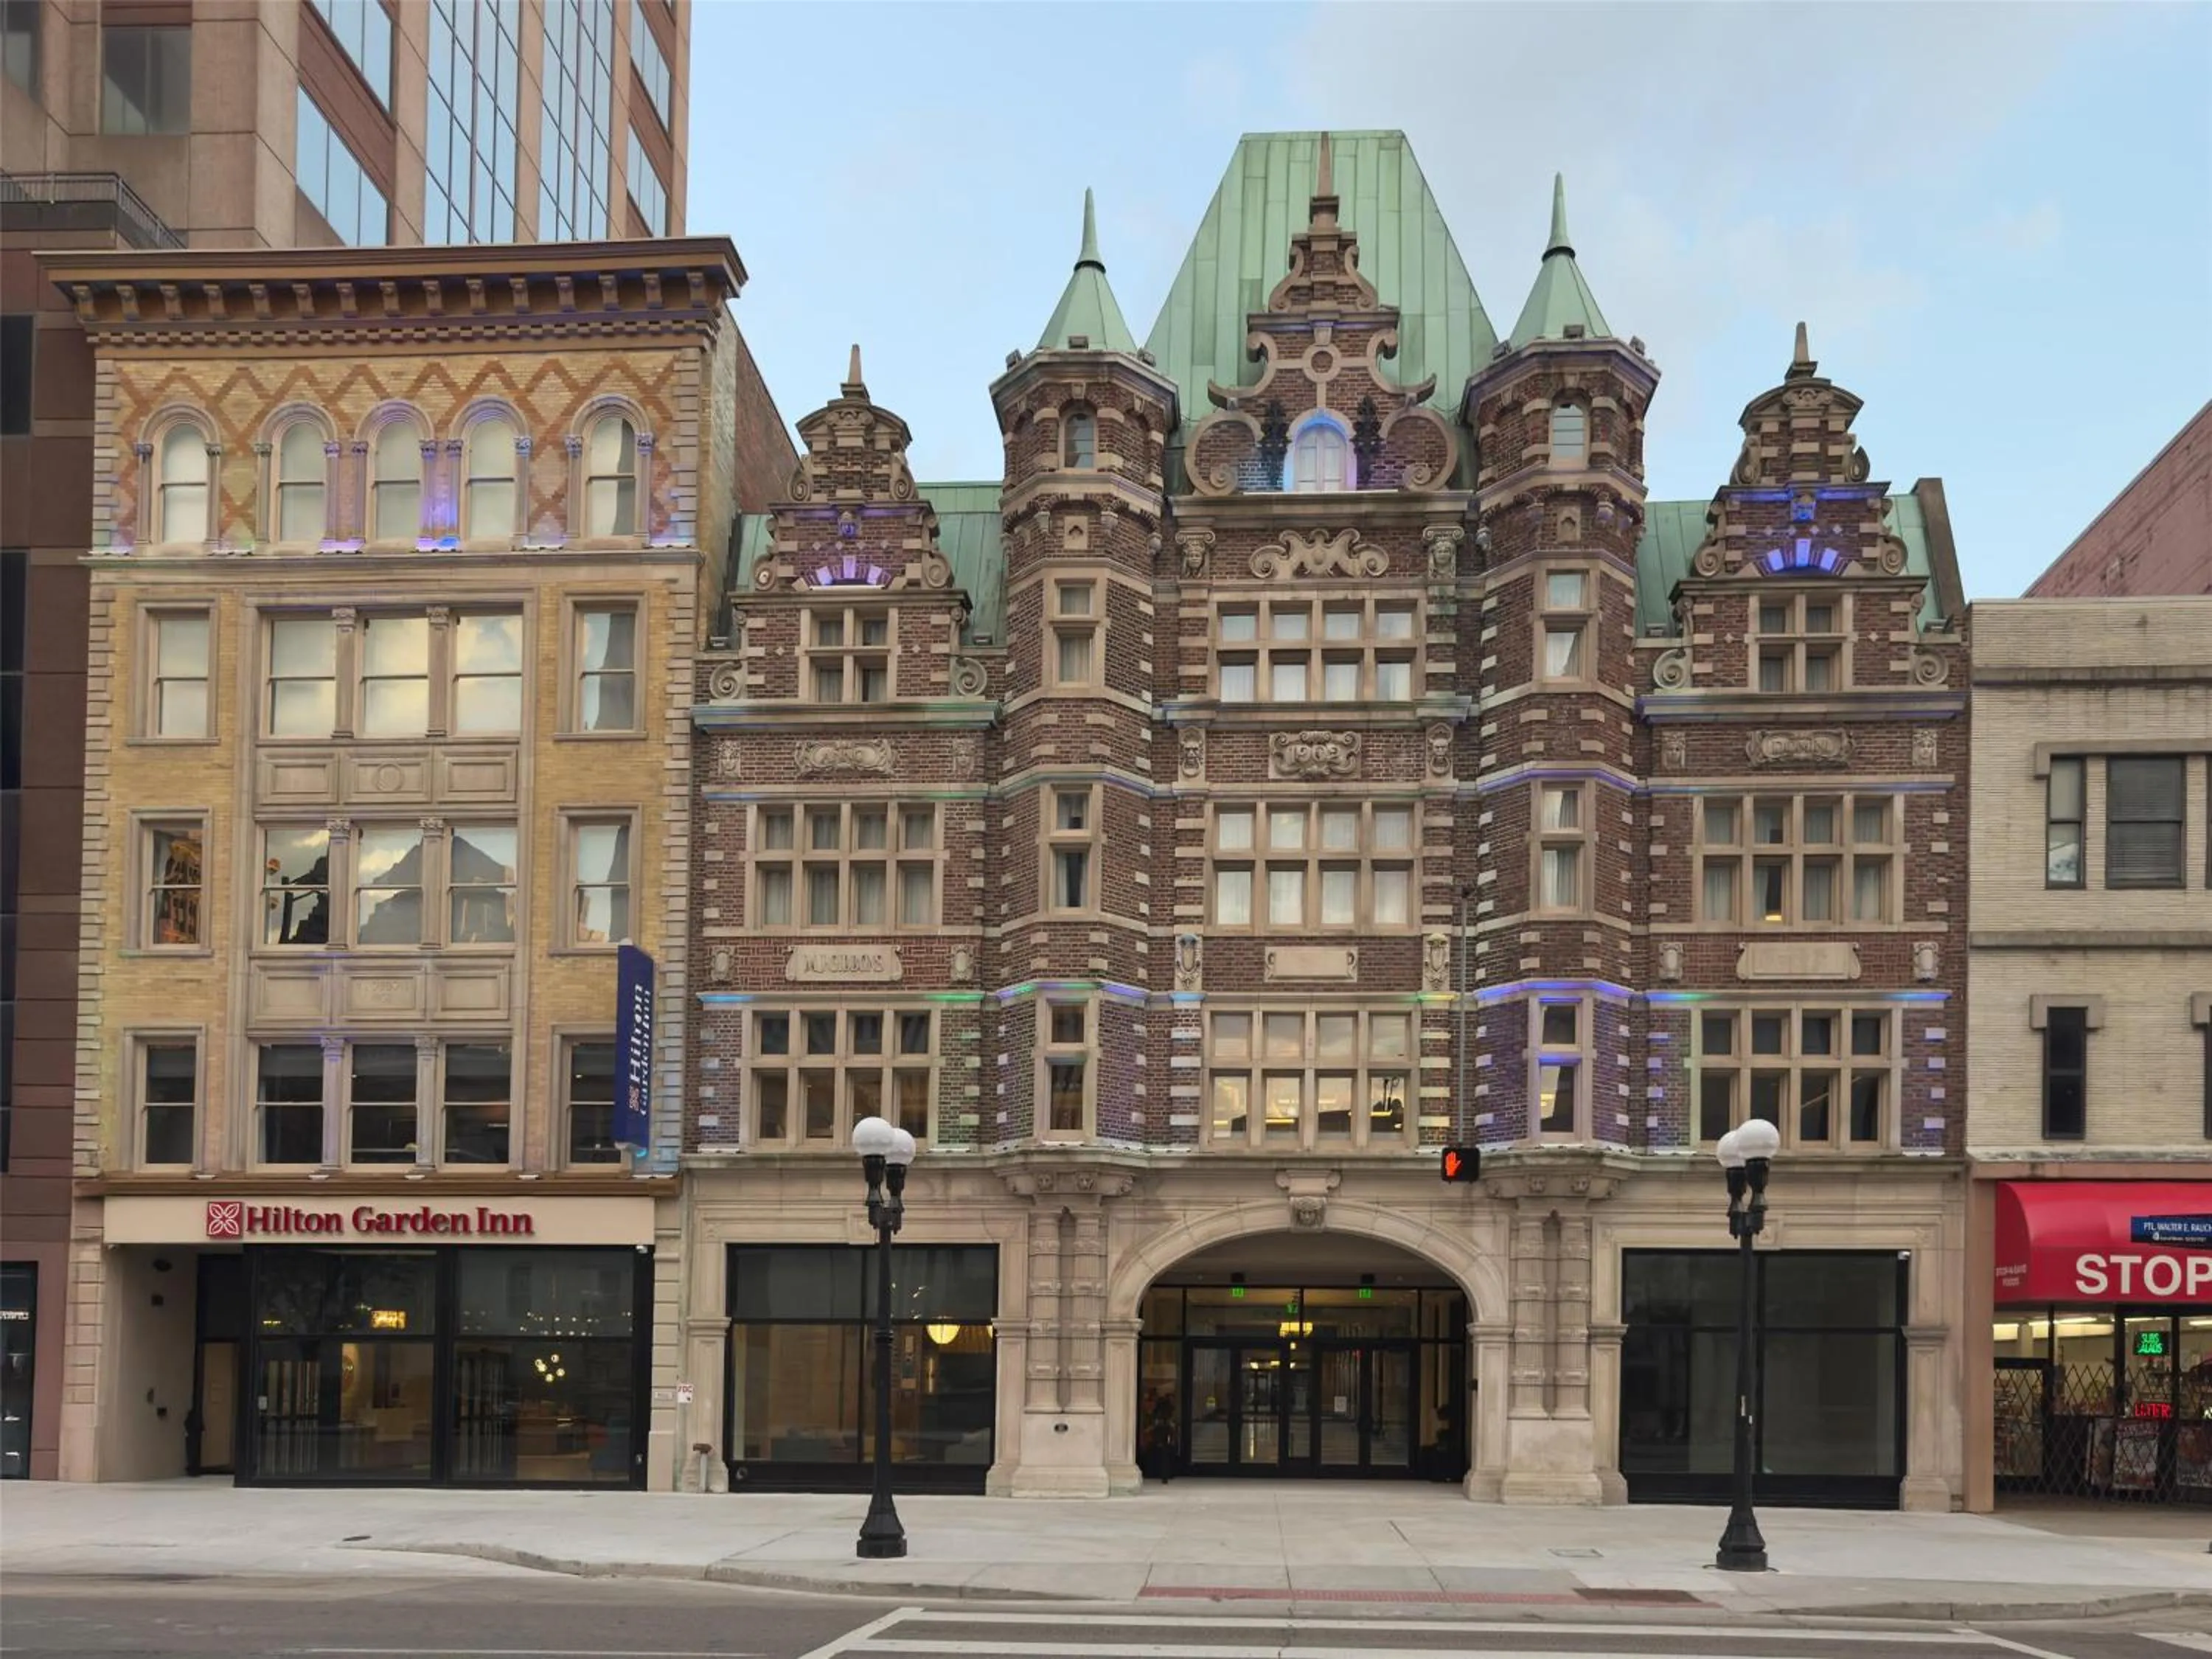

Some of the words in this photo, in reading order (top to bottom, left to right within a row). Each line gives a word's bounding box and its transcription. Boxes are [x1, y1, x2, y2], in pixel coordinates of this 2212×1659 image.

[1285, 742, 1342, 765] 1902
[630, 984, 643, 1083] Hilton
[246, 1206, 344, 1234] Hilton
[352, 1206, 471, 1234] Garden
[476, 1206, 535, 1234] Inn
[2157, 1222, 2183, 1232] WALTER
[2075, 1253, 2212, 1295] STOP
